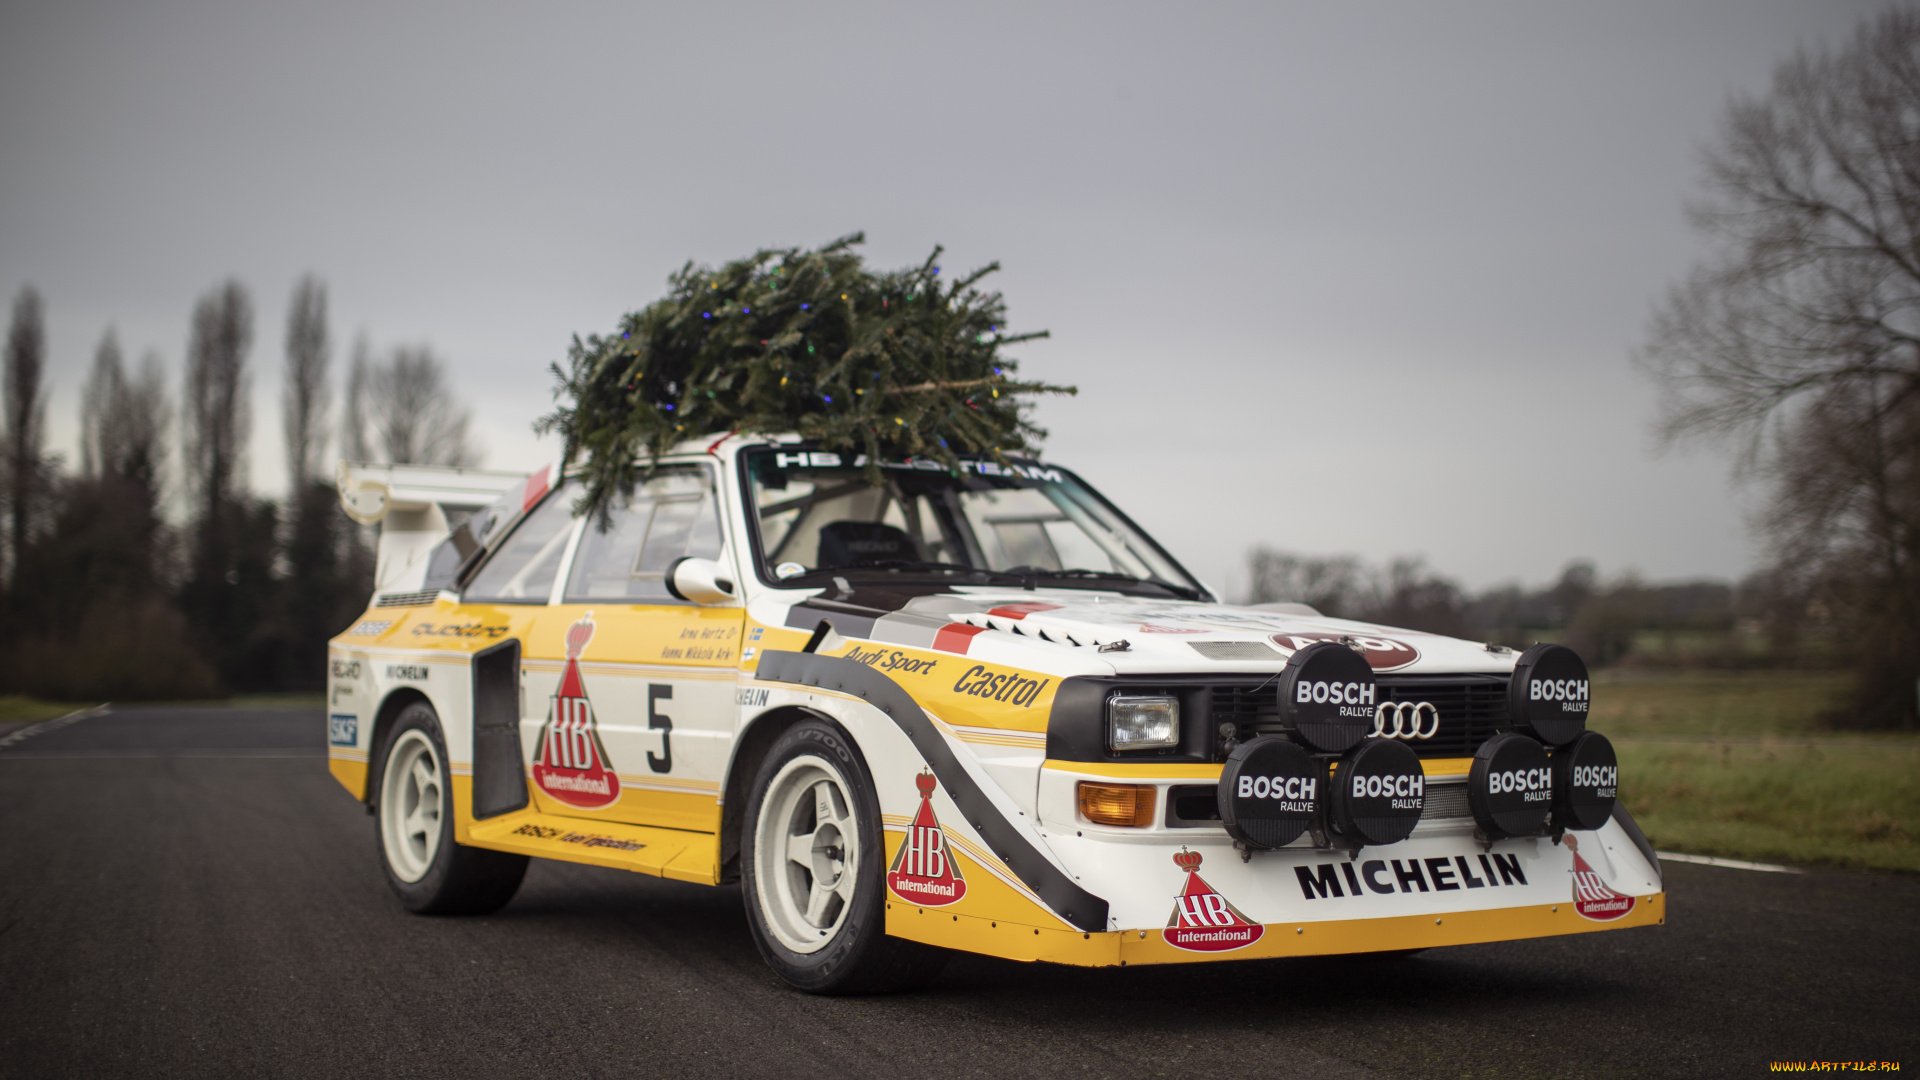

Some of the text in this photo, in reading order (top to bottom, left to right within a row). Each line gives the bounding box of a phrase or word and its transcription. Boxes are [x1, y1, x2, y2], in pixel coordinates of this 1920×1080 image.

[776, 452, 841, 467] HB
[957, 460, 1063, 484] TEAM
[411, 622, 510, 638] quattro
[1286, 635, 1410, 652] ADI
[843, 646, 938, 675] Audi Sport
[953, 664, 1050, 708] Castrol
[1297, 681, 1375, 705] BOSCH
[1530, 679, 1589, 701] BOSCH
[1339, 706, 1373, 717] RALLYE
[1562, 702, 1588, 712] RALLYE
[331, 717, 356, 743] SKF
[547, 695, 593, 771] HB
[646, 683, 673, 774] 5
[798, 730, 849, 762] V700
[541, 769, 611, 795] international
[1238, 775, 1316, 800] BOSCH
[1352, 775, 1423, 798] BOSCH
[1489, 767, 1552, 794] BOSCH
[1573, 766, 1617, 787] BOSCH
[1391, 799, 1422, 809] RALLYE
[1524, 790, 1552, 802] RALLYE
[1597, 788, 1616, 798] RALLYE
[1280, 801, 1314, 812] RALLYE
[905, 825, 945, 878] HB
[896, 877, 955, 896] international
[1293, 853, 1529, 900] MICHELIN
[1568, 869, 1616, 901] HB
[1172, 893, 1236, 928] HB
[1583, 898, 1628, 913] international
[1176, 928, 1251, 943] international
